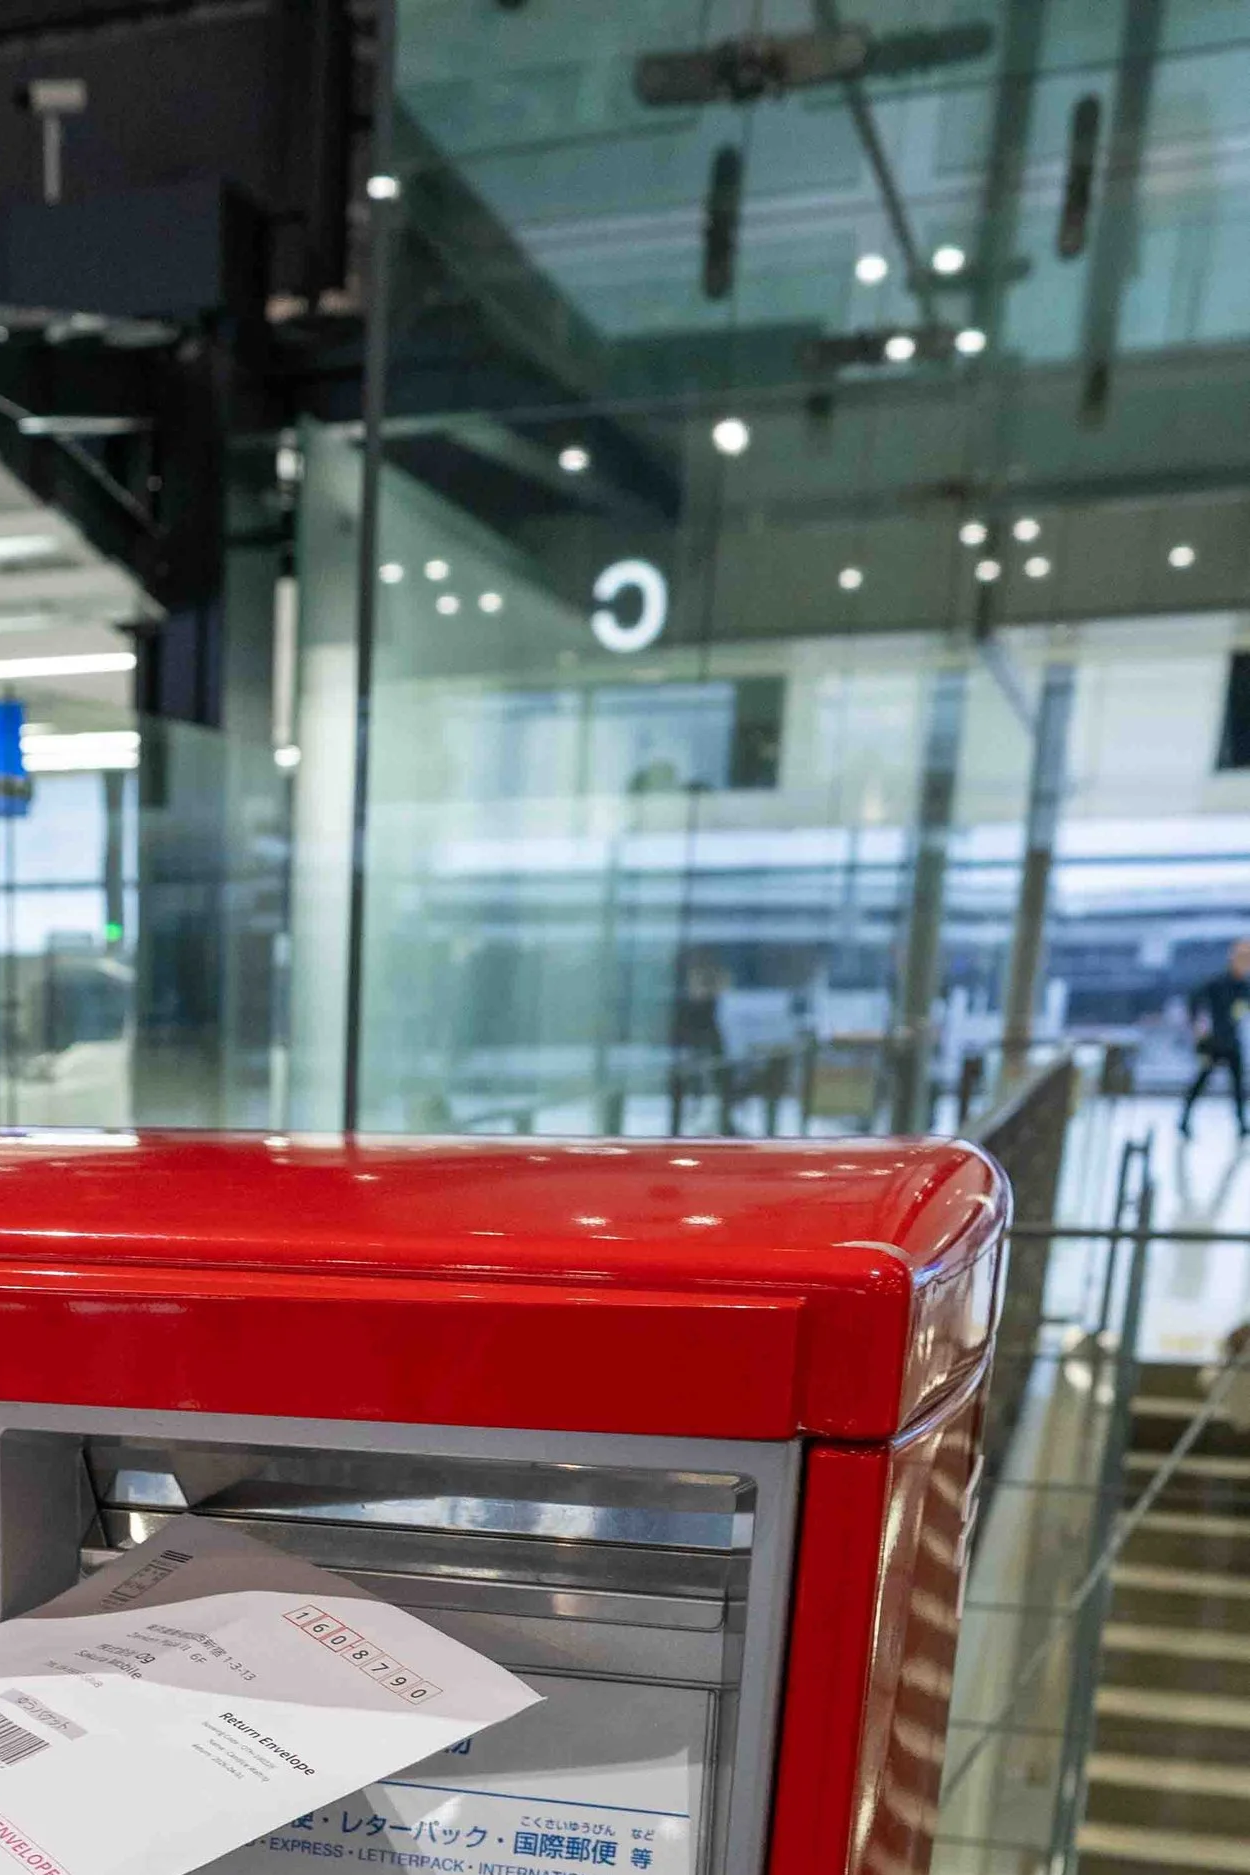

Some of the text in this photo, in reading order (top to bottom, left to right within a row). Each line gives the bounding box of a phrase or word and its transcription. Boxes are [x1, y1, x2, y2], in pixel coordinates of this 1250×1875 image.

[218, 1712, 261, 1739] Return
[258, 1737, 315, 1776] Envelope
[521, 1815, 655, 1841] こくさいゆうびん など
[269, 1837, 344, 1858] EXPRESS
[358, 1847, 465, 1874] LETTERPACK
[630, 1847, 654, 1870] 等
